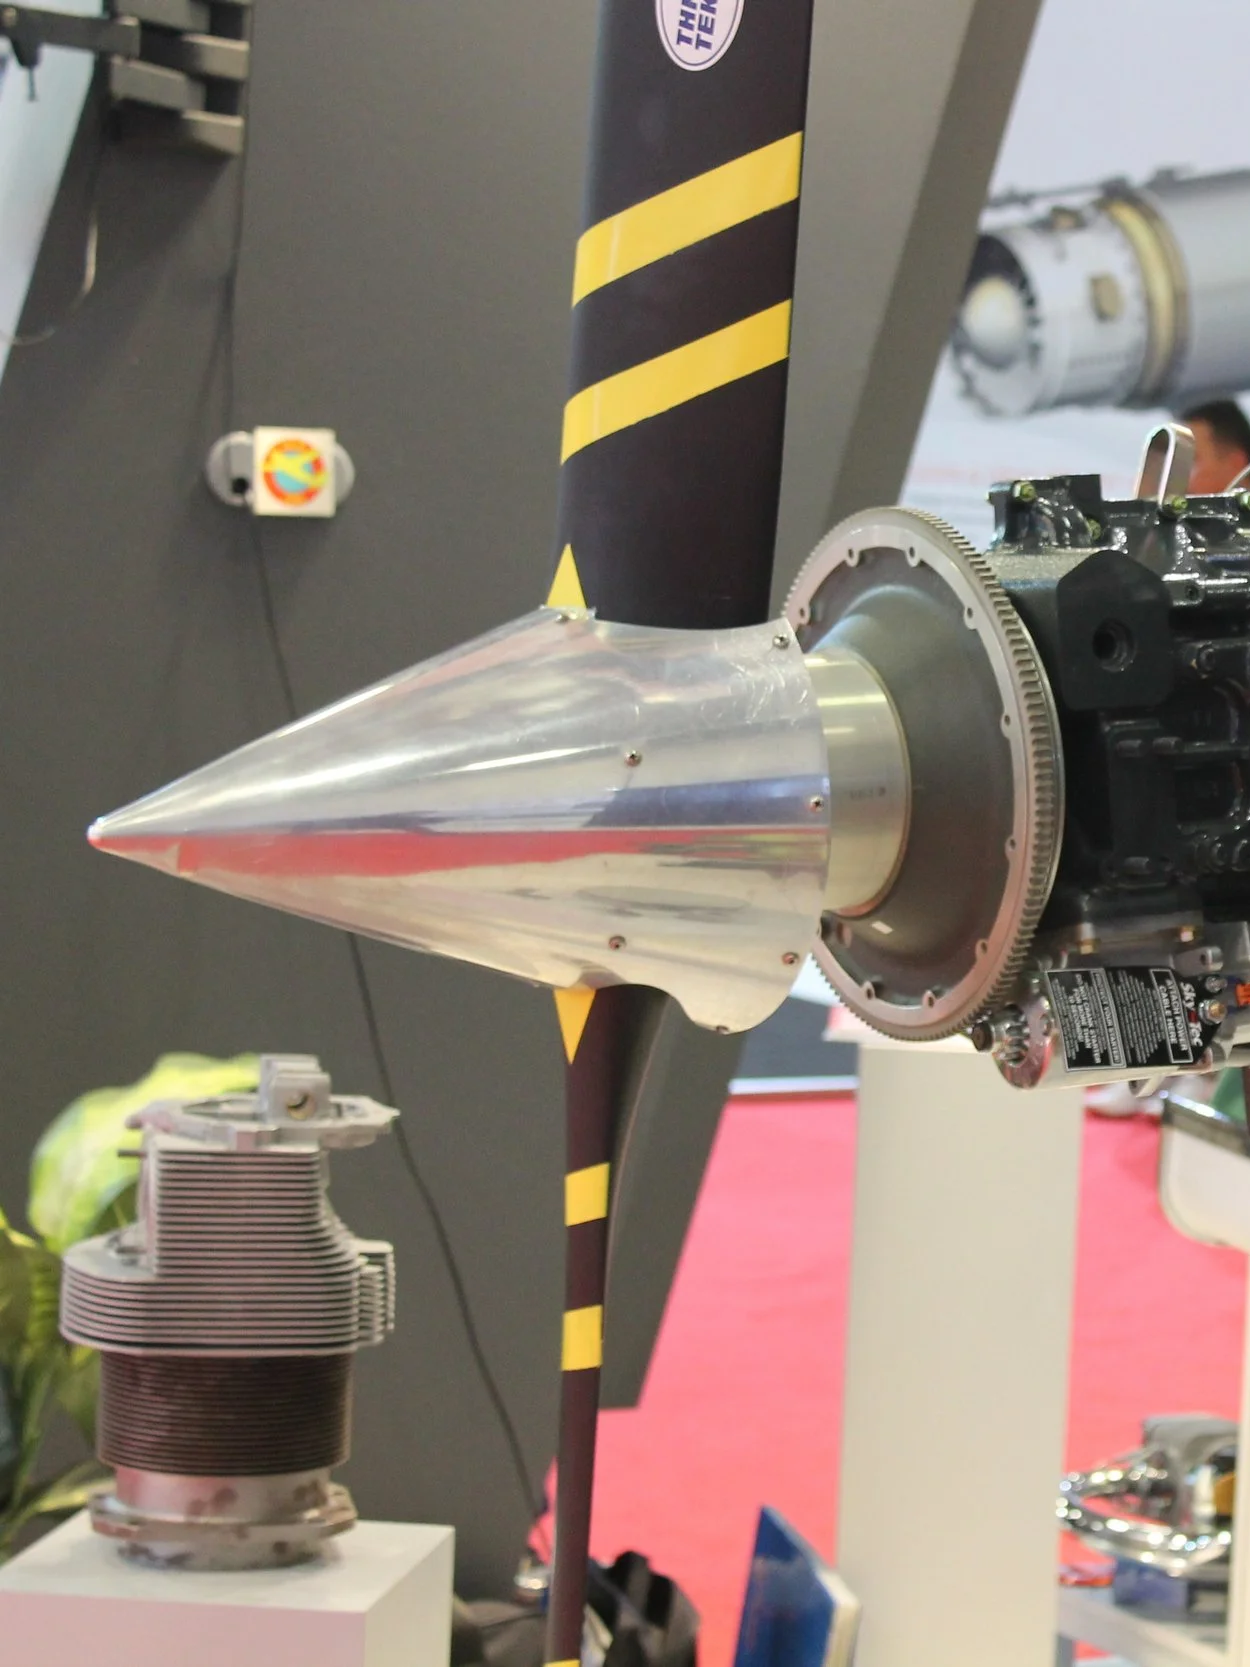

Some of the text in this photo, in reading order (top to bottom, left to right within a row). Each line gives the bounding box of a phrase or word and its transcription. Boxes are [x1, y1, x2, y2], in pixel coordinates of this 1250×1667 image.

[1083, 1001, 1094, 1028] CRANK
[1089, 1028, 1102, 1064] STARTER
[1104, 1006, 1114, 1027] YOUR
[1160, 985, 1178, 1044] CABLE HERE
[1165, 979, 1189, 1051] ATTACH POWER
